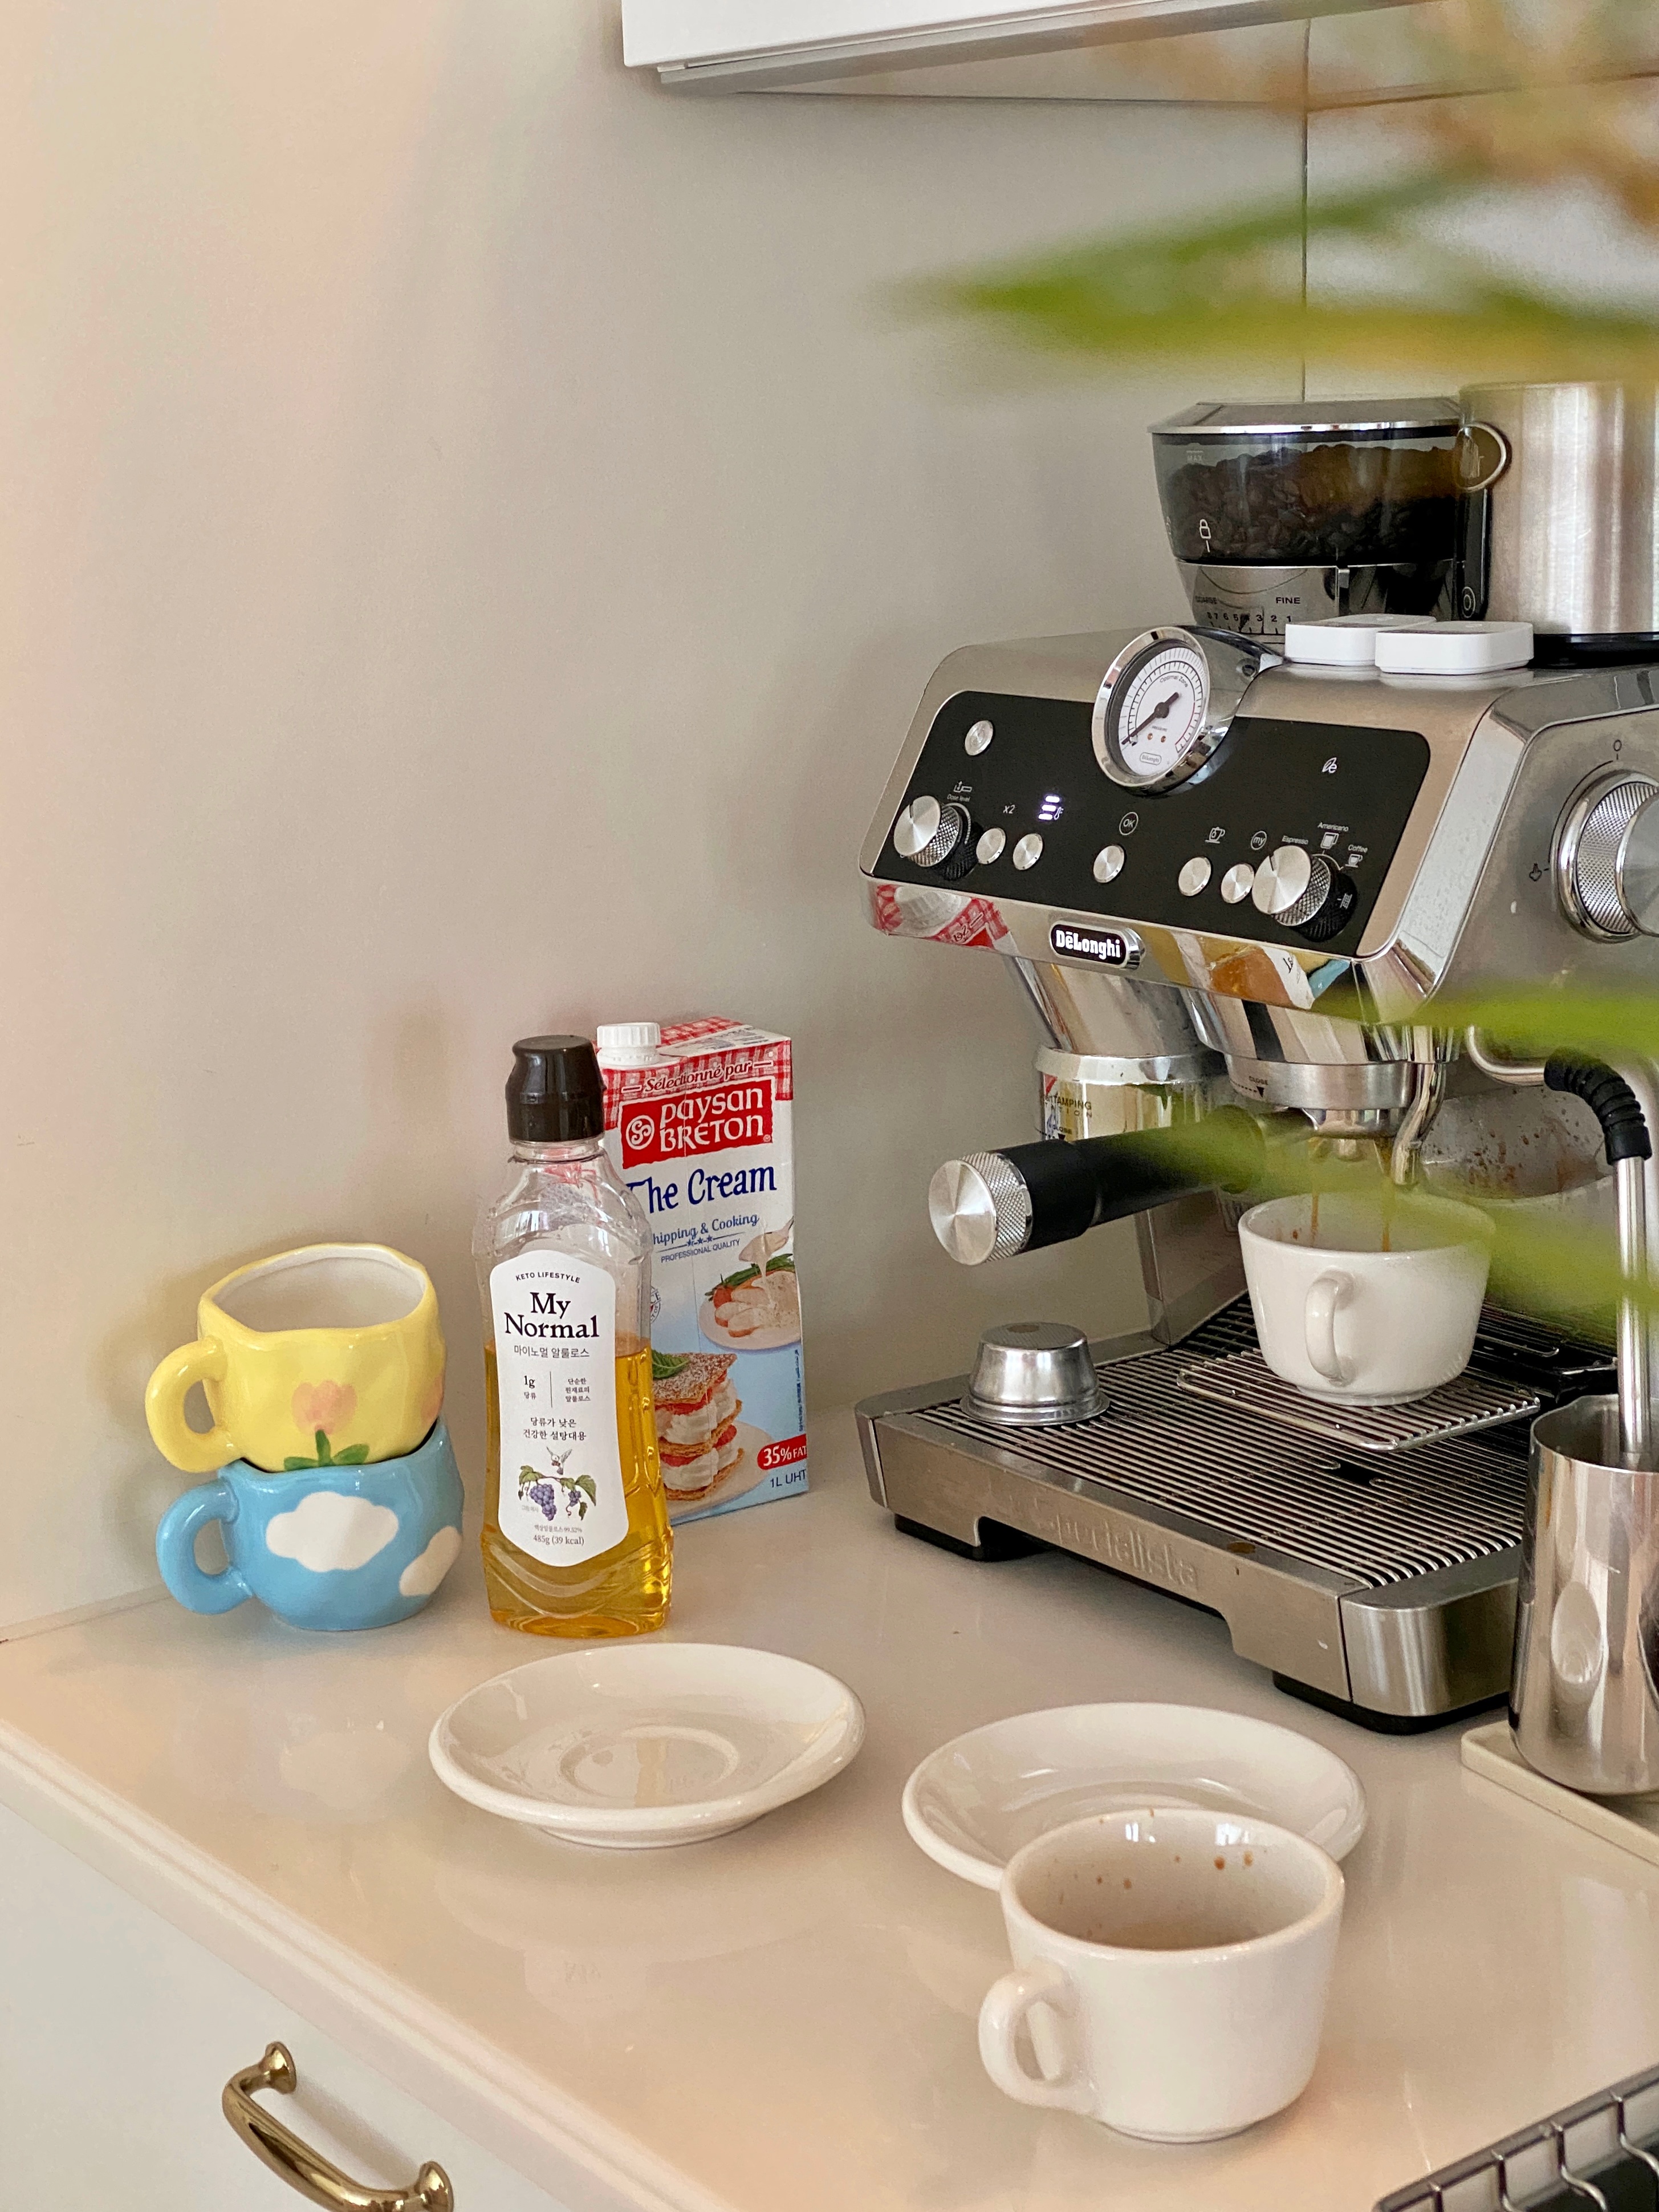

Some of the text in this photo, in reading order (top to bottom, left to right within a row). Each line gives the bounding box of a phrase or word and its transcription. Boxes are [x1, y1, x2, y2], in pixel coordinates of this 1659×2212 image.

[1123, 818, 1136, 829] OK
[1317, 822, 1349, 833] Americano
[1254, 836, 1266, 846] my
[1282, 835, 1309, 845] Espresso
[1348, 844, 1368, 854] Coffee
[725, 1060, 752, 1080] par
[688, 1166, 777, 1206] Cream
[653, 1213, 760, 1247] hipping & Cooking
[660, 1238, 741, 1263] PROFESSIONAL QUALITY
[515, 1271, 581, 1284] KETO LIFESTYLE
[530, 1292, 571, 1320] My
[503, 1312, 600, 1338] Normal
[514, 1344, 591, 1359] 마이노멀 알룰로스
[523, 1374, 536, 1389] 1g
[523, 1391, 537, 1401] 당류
[530, 1417, 577, 1428] 당류가 낮은
[523, 1428, 587, 1441] 건강한 설탕대용
[763, 1444, 807, 1467] 35% FAT
[770, 1468, 807, 1488] 1L UHT
[532, 1534, 585, 1547] 485g (39 kcal)
